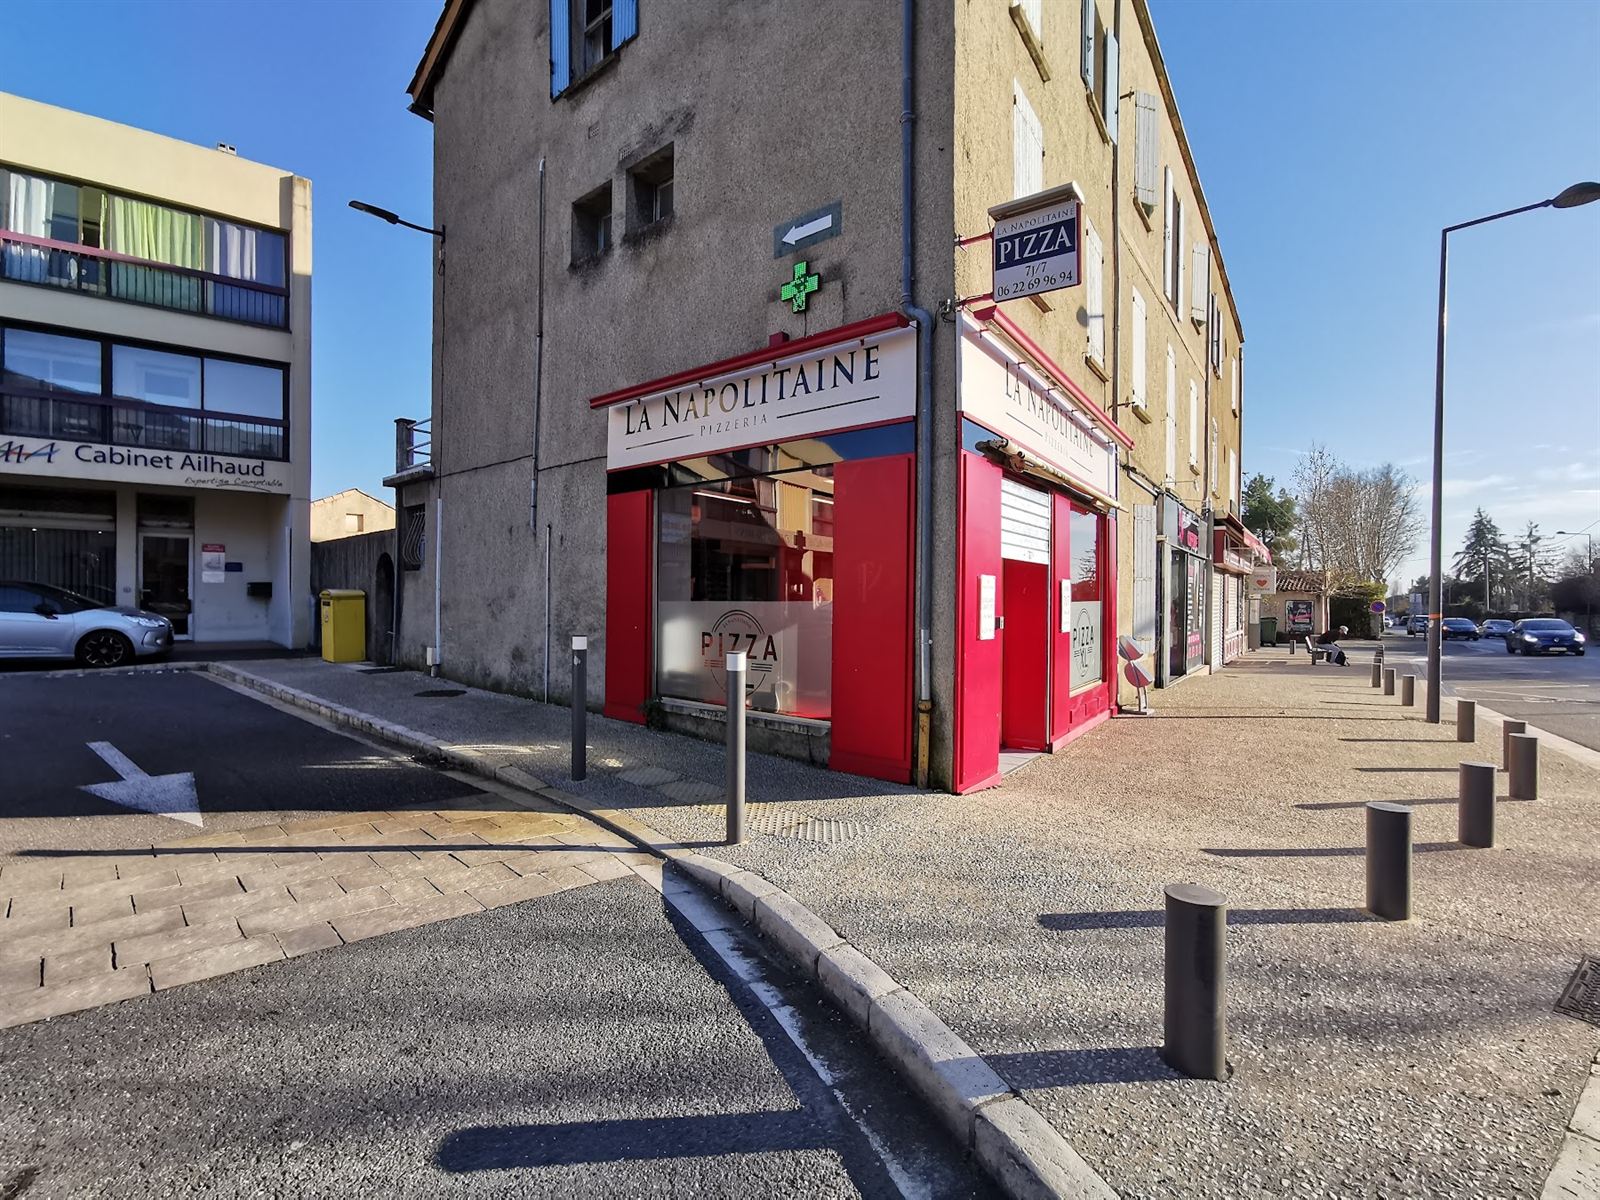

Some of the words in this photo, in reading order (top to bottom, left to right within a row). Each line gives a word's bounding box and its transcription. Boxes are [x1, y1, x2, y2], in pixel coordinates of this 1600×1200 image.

[997, 227, 1007, 236] LA
[1010, 208, 1074, 231] NAPOLITAINE
[999, 225, 1072, 264] PIZZA
[997, 286, 1010, 297] 06
[1012, 281, 1026, 294] 22
[1027, 277, 1041, 290] 69
[1043, 274, 1057, 286] 96
[1059, 270, 1073, 283] 94
[625, 401, 652, 435] LA
[662, 345, 880, 427] NAPOLITAINE
[1005, 361, 1022, 406] LA
[700, 413, 769, 437] PIZZERIA
[74, 444, 173, 470] Cabinet
[180, 454, 265, 477] Ailhaud
[701, 632, 777, 661] PIZZA
[1072, 625, 1095, 649] PIZZA
